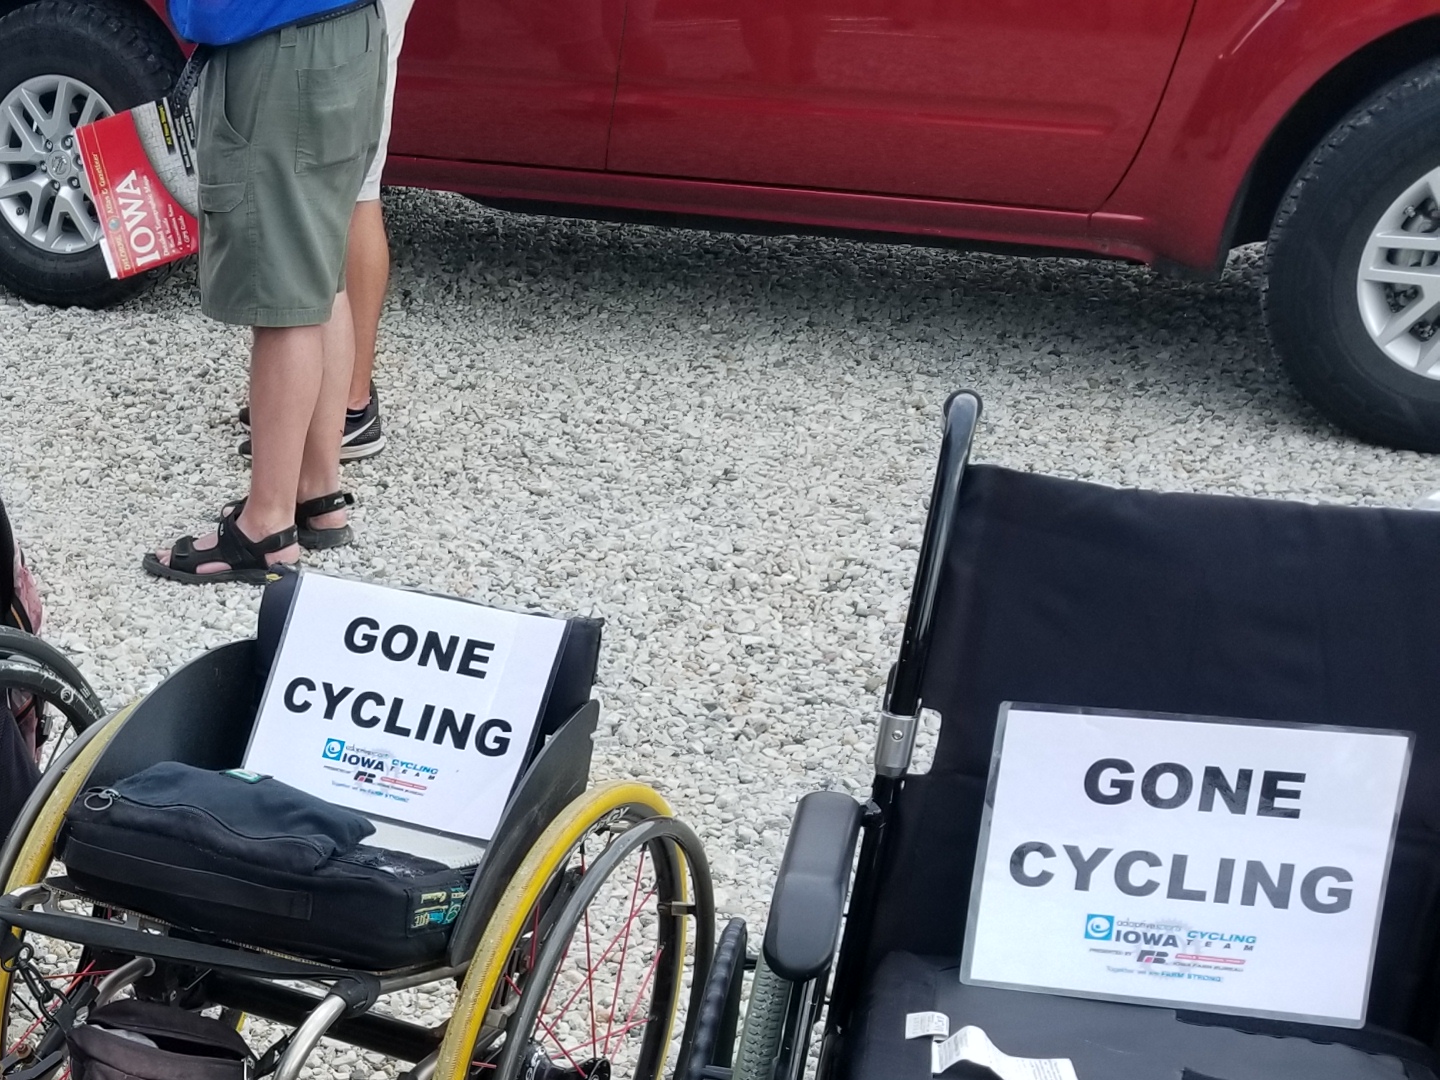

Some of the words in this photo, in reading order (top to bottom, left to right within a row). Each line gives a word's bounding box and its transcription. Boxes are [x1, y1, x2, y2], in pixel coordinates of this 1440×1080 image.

[115, 169, 161, 267] IOWA
[343, 616, 495, 680] GONE
[283, 676, 513, 757] CYCLING
[342, 752, 385, 772] IOWA
[391, 758, 438, 775] CYCLING
[1084, 758, 1306, 819] GONE
[1009, 841, 1354, 915] CYCLING
[1115, 930, 1179, 948] IOWA
[1187, 930, 1257, 944] CYCLING
